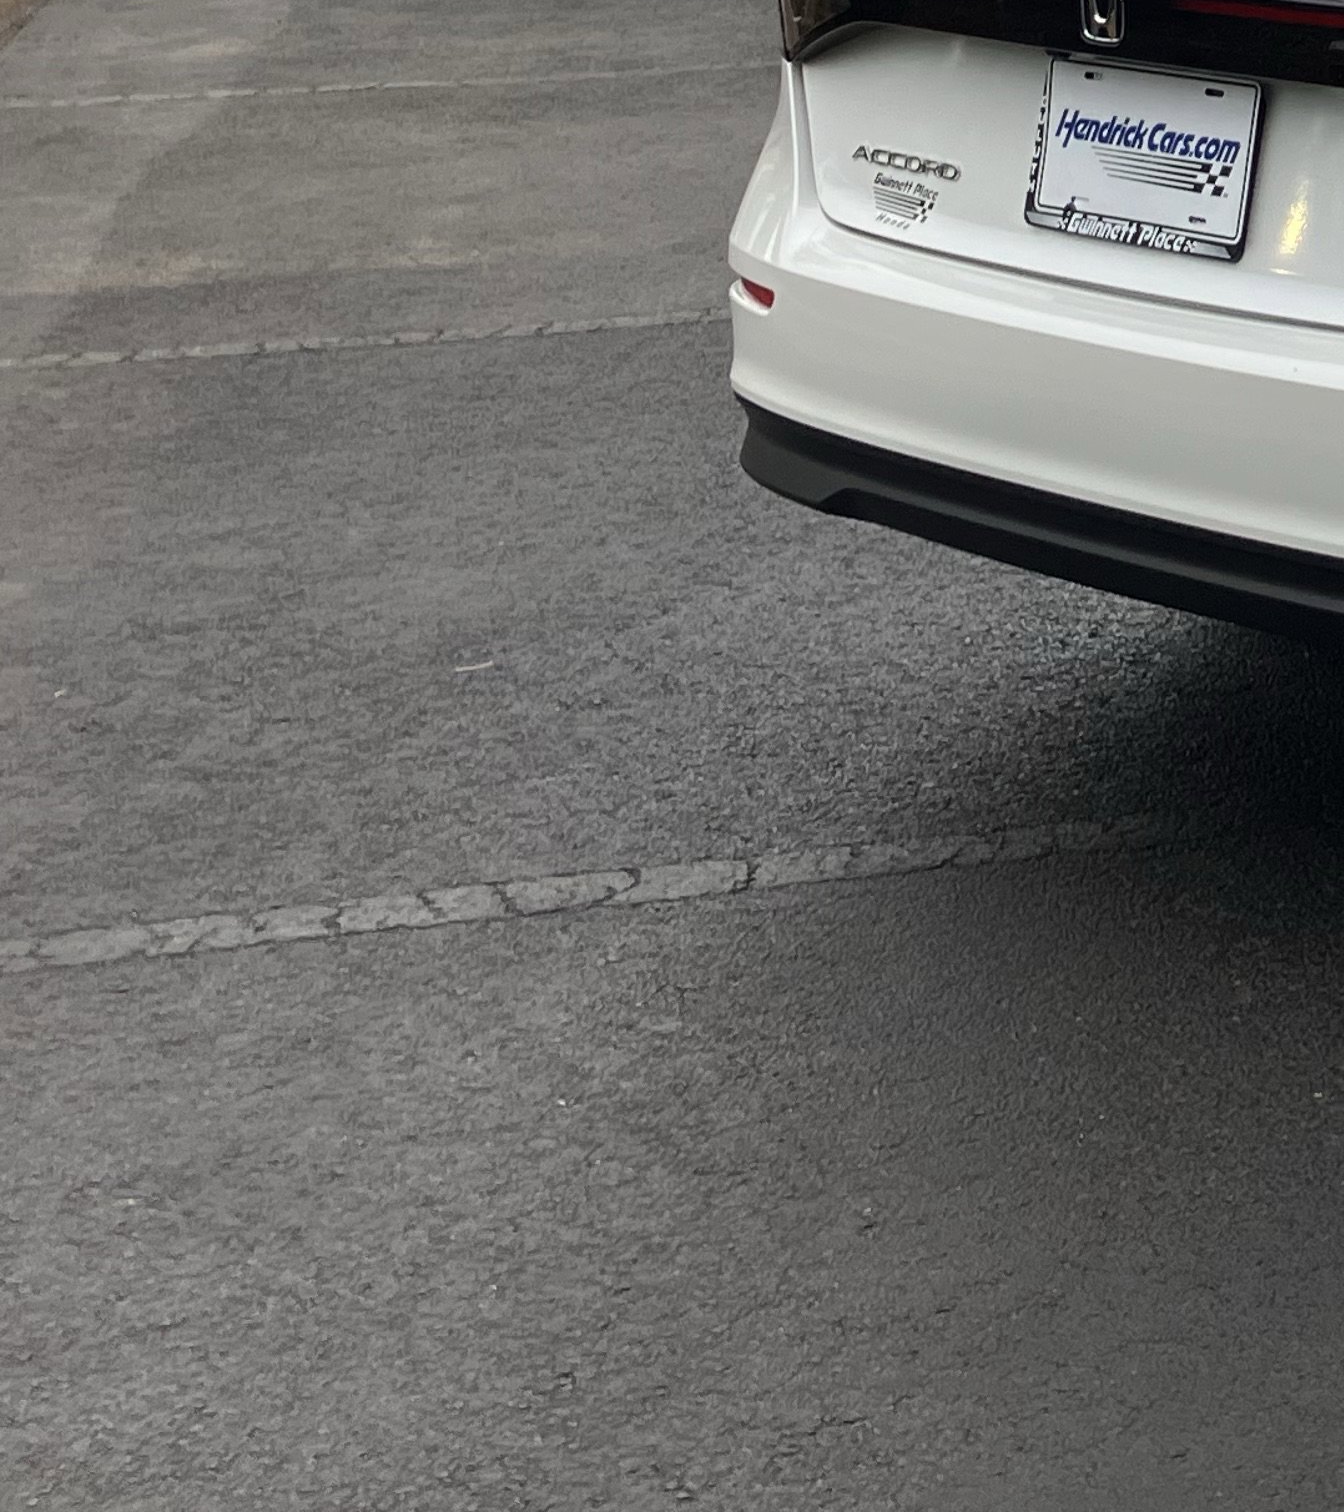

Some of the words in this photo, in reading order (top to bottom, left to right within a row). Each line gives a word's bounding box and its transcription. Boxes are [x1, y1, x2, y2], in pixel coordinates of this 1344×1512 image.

[851, 144, 961, 182] ACCORD
[873, 171, 914, 194] Gwinnett
[913, 182, 940, 202] Place
[1067, 211, 1139, 244] Gwinnett
[1136, 223, 1187, 253] Place
